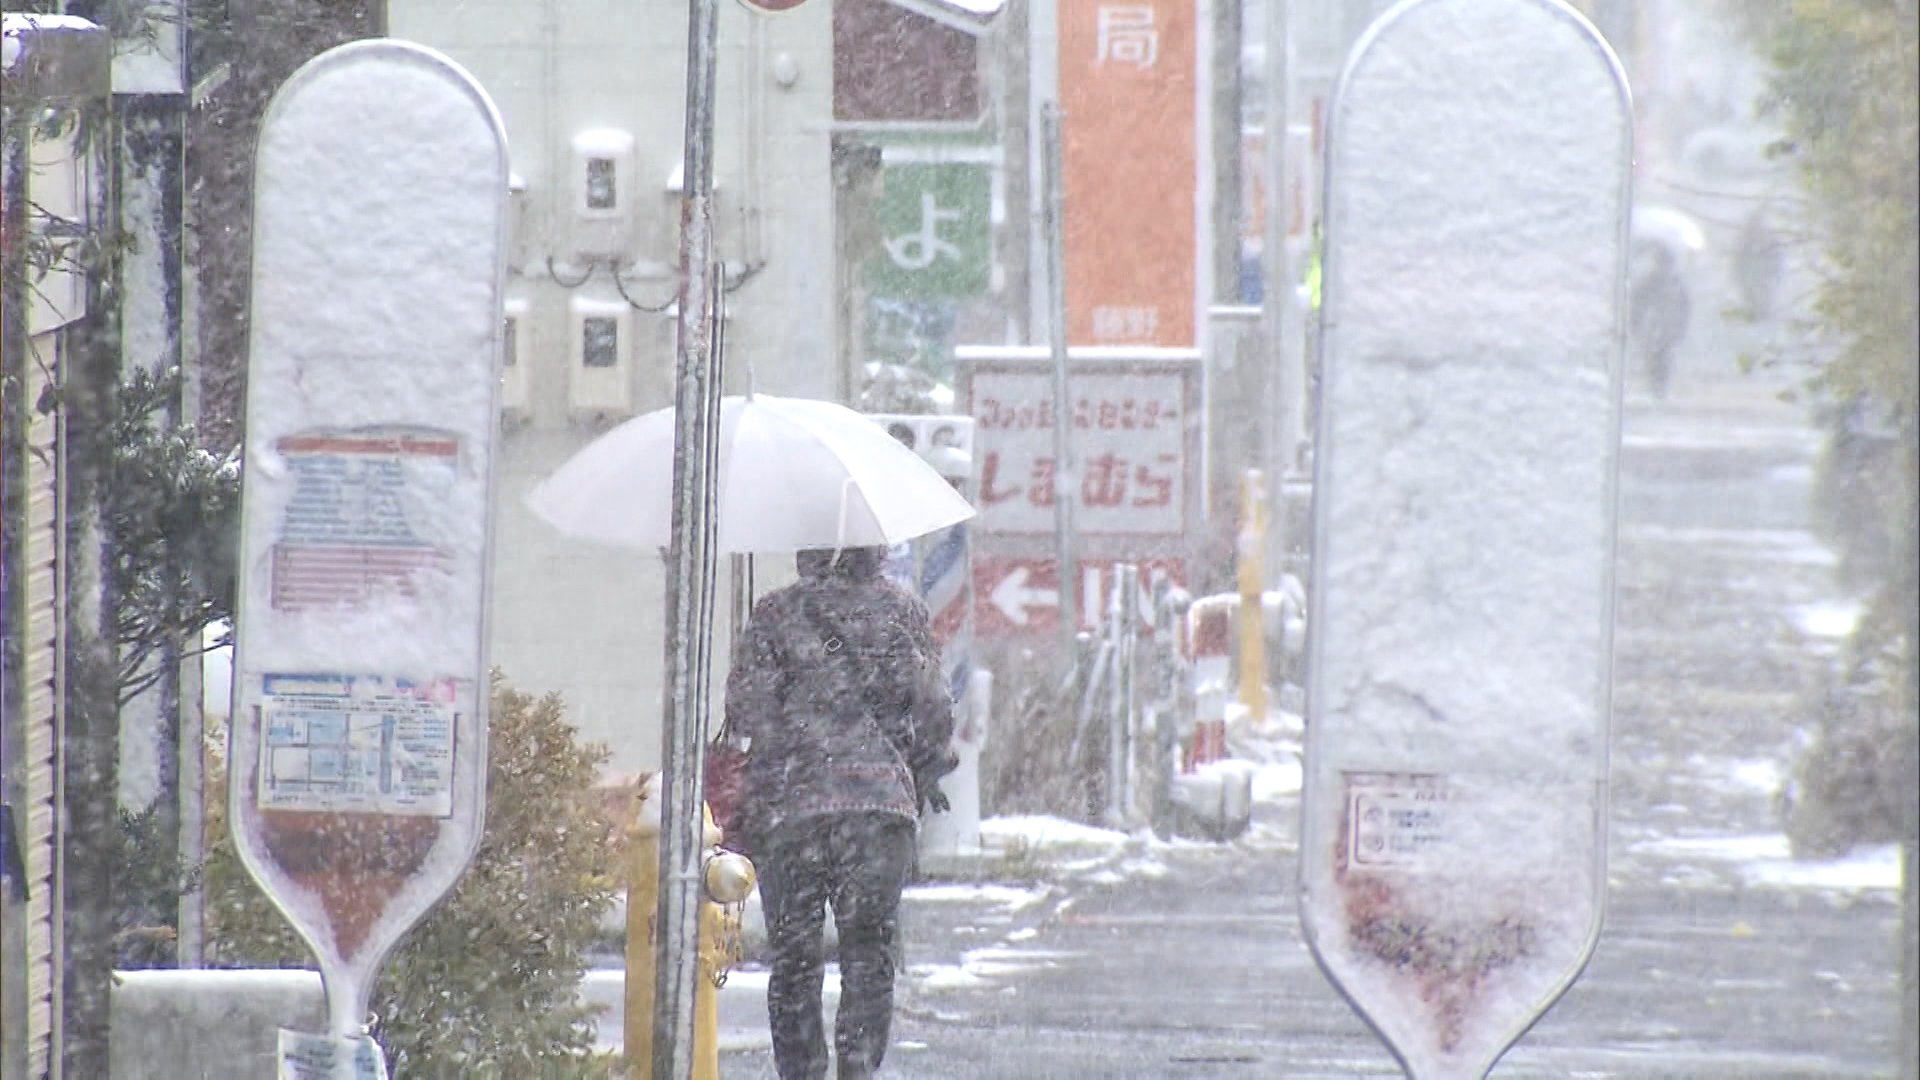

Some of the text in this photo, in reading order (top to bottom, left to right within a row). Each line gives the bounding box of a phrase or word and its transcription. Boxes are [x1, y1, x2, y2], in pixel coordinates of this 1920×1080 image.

[1097, 4, 1158, 69] 局
[886, 191, 961, 270] よ
[979, 450, 1176, 507] しまむら
